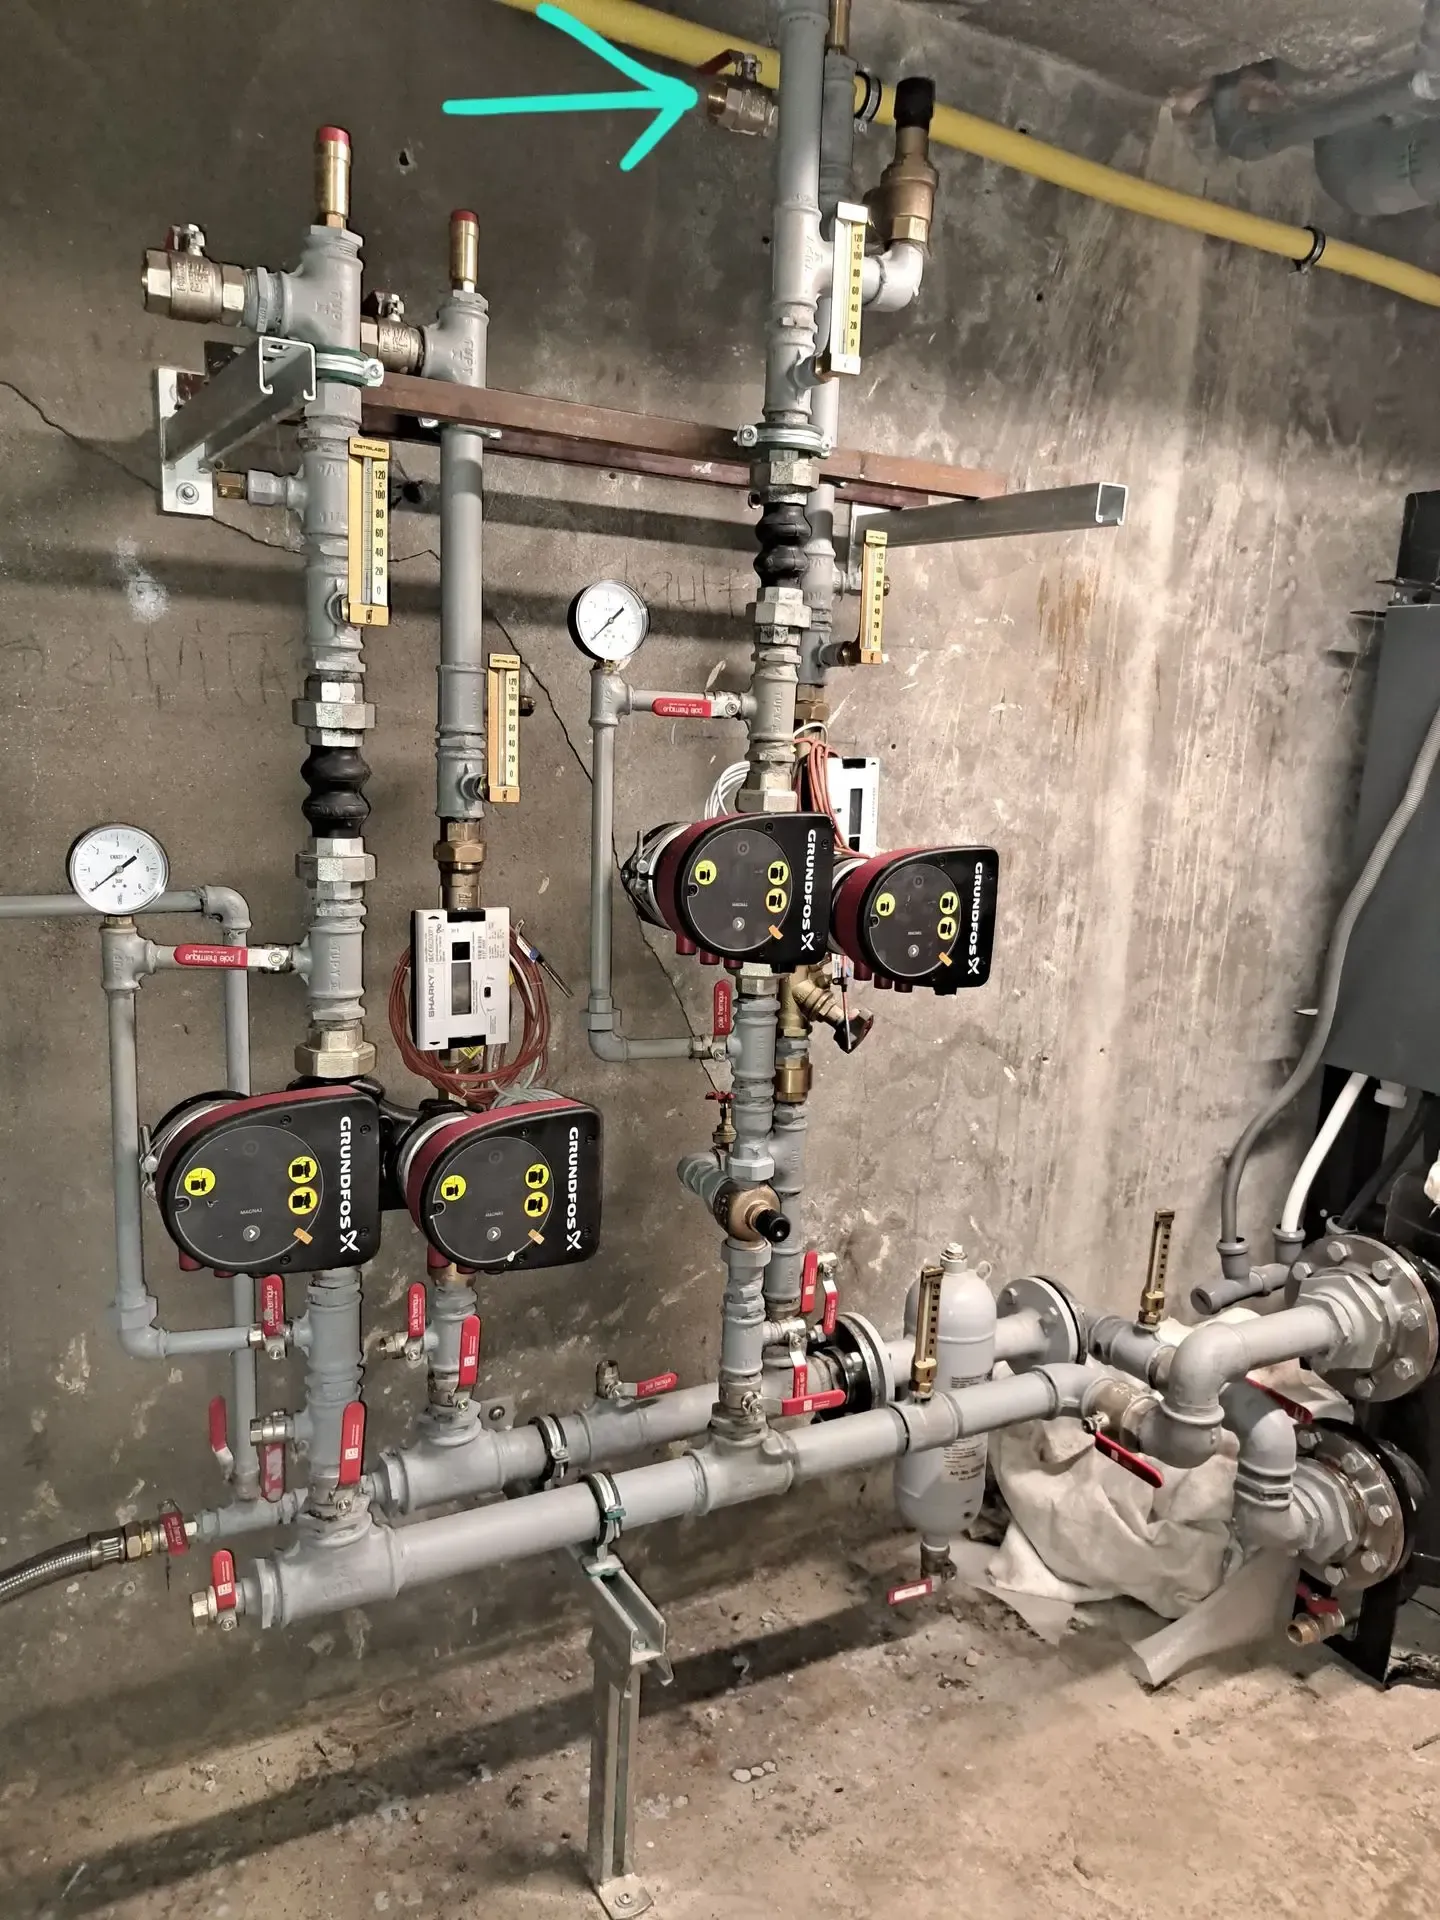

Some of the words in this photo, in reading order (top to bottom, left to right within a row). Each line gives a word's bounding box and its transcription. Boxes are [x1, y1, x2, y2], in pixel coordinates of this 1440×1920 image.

[374, 470, 386, 480] 120
[374, 489, 386, 500] 100
[375, 509, 385, 519] 80
[375, 528, 384, 538] 60
[374, 547, 384, 557] 40
[374, 566, 384, 576] 20
[376, 586, 382, 595] 0
[801, 828, 817, 931] GRUNDFOS
[967, 861, 983, 956] GRUNDFOS
[427, 974, 436, 1018] SHARKY
[339, 1116, 352, 1230] GRUNDFOS
[566, 1126, 579, 1231] GRUNDFOS
